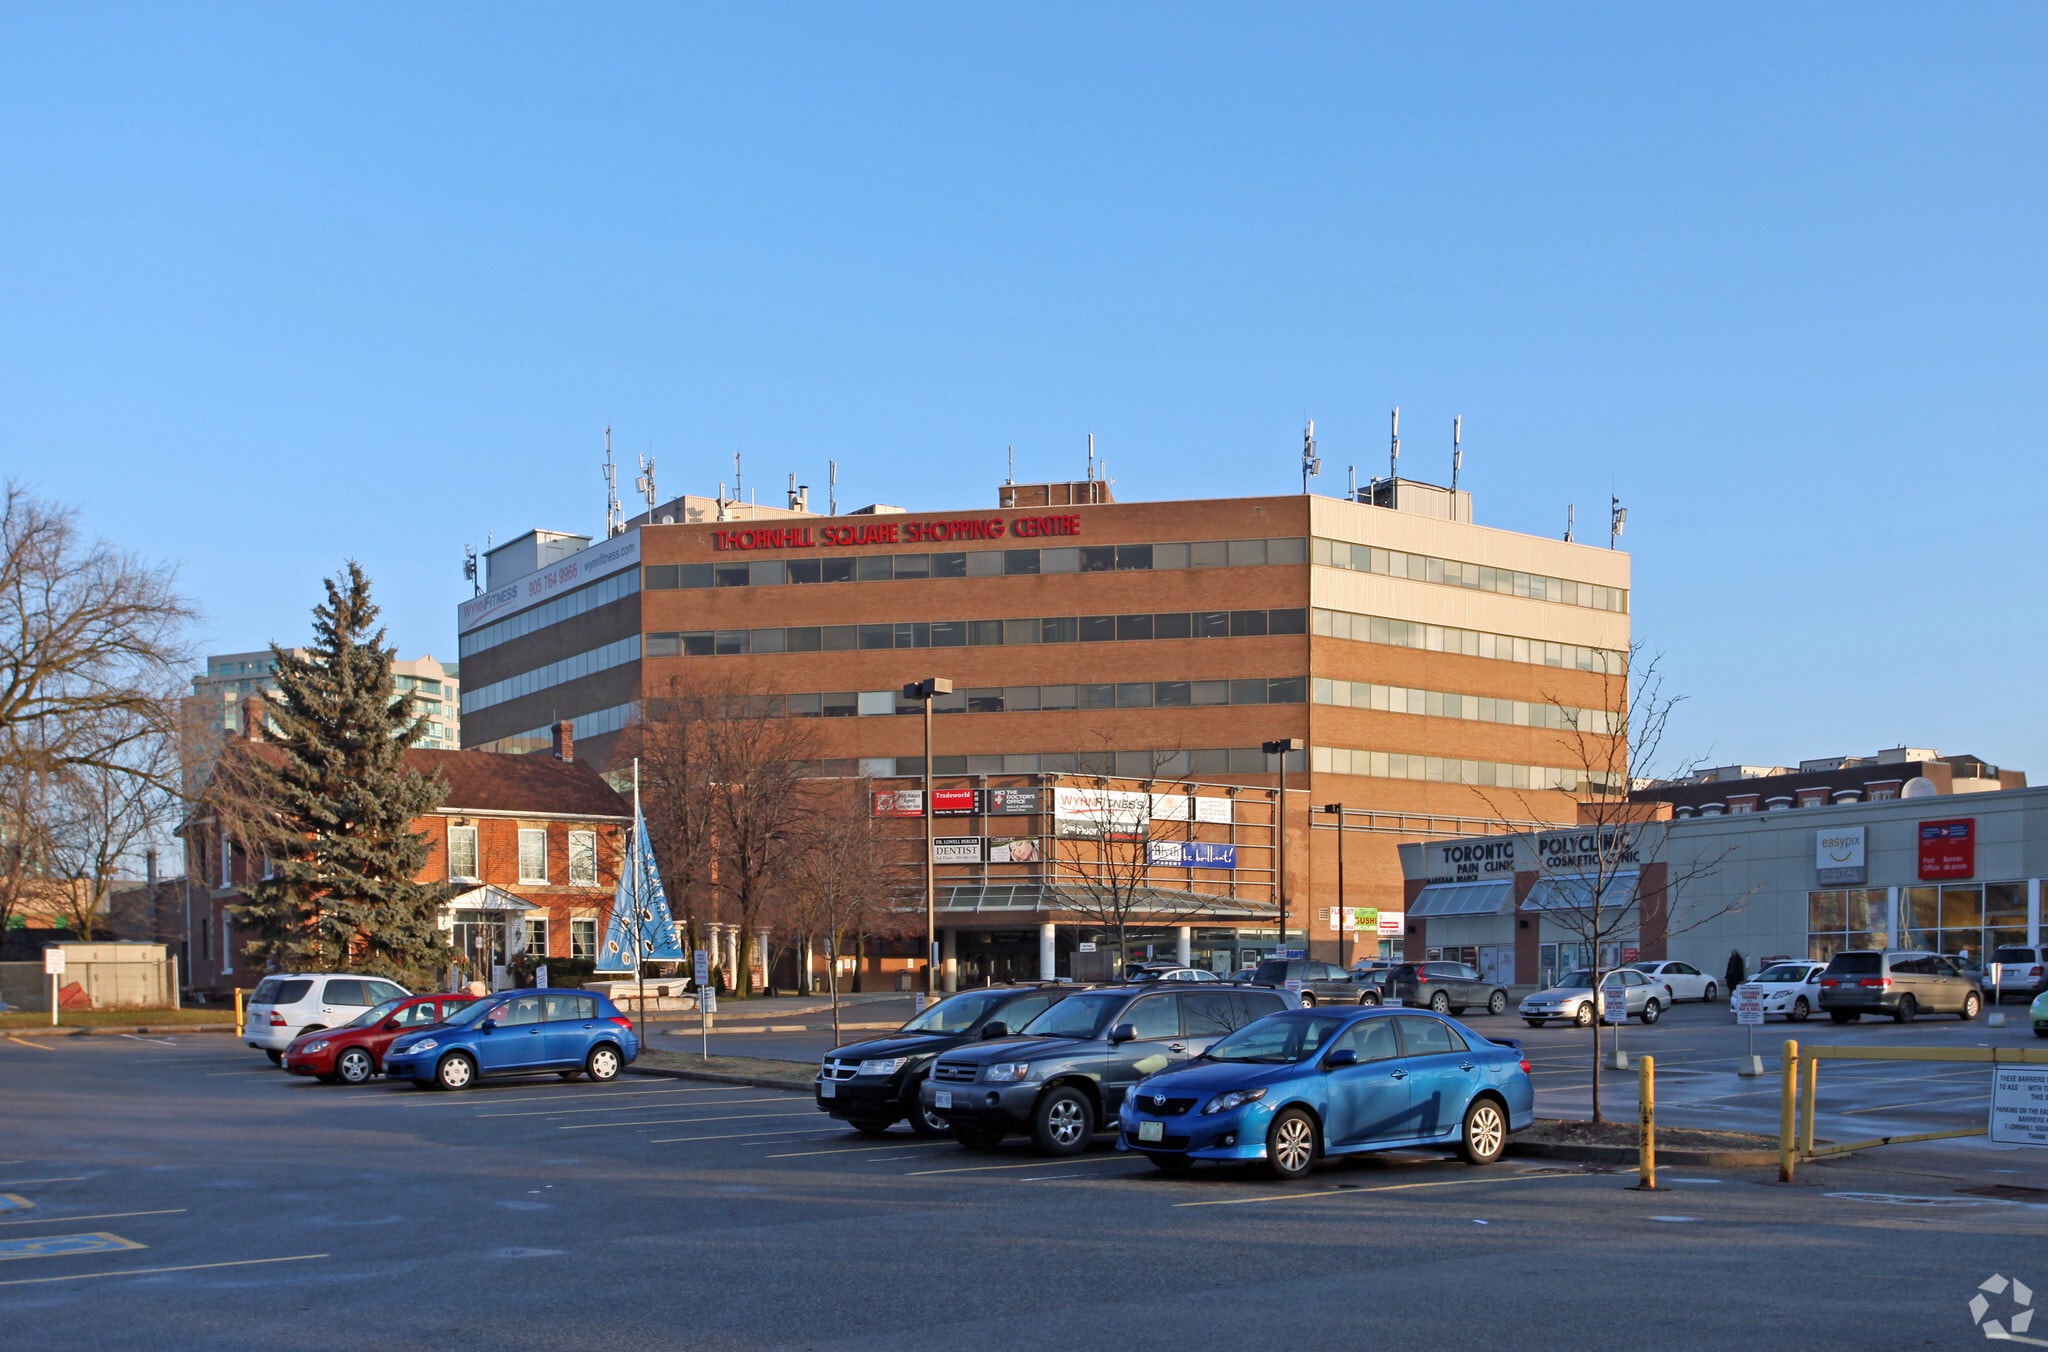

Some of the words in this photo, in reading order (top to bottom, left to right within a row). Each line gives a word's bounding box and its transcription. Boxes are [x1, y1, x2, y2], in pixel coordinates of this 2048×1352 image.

[716, 526, 816, 551] THORNHILL
[824, 522, 899, 547] SQUARE
[907, 518, 1006, 543] SHOPPING
[1014, 514, 1081, 538] CENTRE
[583, 543, 635, 573] wynnfitness.com
[528, 577, 543, 597] 905
[543, 571, 558, 592] 764
[559, 562, 578, 585] 9966
[463, 585, 518, 619] WYNNFITNESS
[935, 791, 971, 799] Tradeworld
[1060, 794, 1145, 811] WYNNFITNESS
[1076, 825, 1097, 836] Floor
[1821, 835, 1860, 849] easypix
[936, 846, 977, 855] DENTIST
[1182, 846, 1194, 861] be
[1195, 844, 1234, 863] brilliant!
[1442, 842, 1514, 863] TORONTO
[1457, 862, 1479, 874] PAIN
[1484, 860, 1515, 872] CLINIC
[1546, 854, 1599, 868] COSMETIC
[1820, 869, 1859, 878] DIGITAL
[1355, 917, 1377, 925] SUSHI
